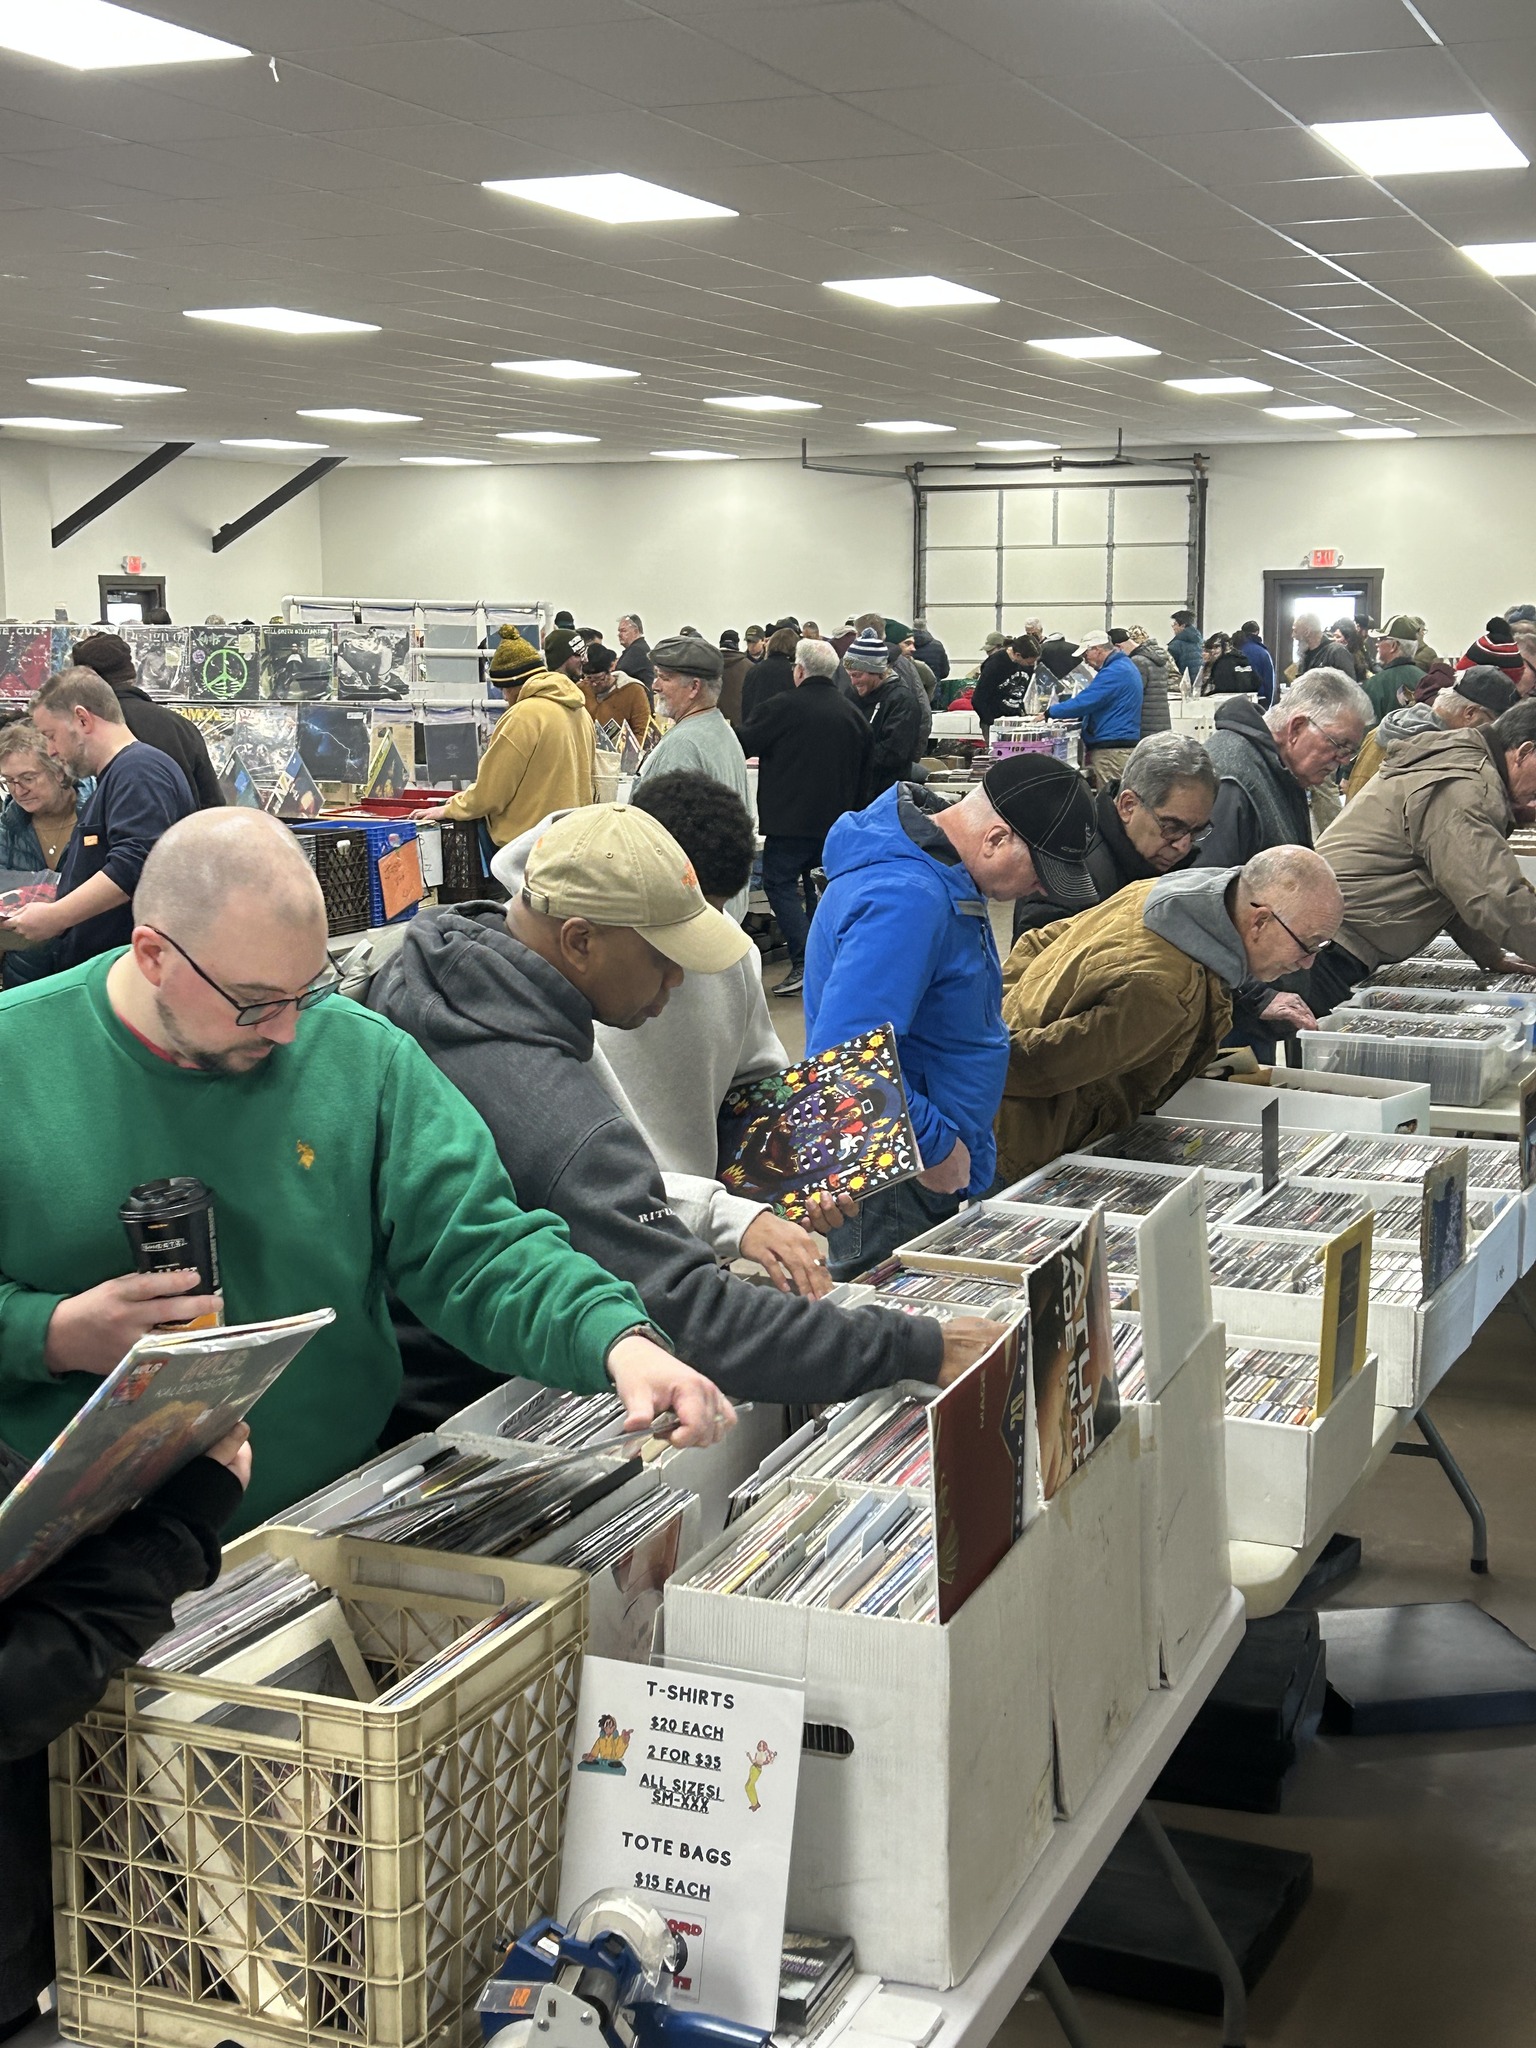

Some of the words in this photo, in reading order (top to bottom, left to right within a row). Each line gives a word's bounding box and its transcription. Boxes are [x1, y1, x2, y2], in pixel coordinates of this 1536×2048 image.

[638, 1207, 676, 1223] RITU
[646, 1680, 735, 1710] T-SHIRTS
[650, 1716, 678, 1733] $20
[682, 1721, 724, 1740] EACH
[647, 1745, 656, 1759] 2
[660, 1747, 690, 1765] FOR
[695, 1753, 721, 1770] $35
[640, 1773, 667, 1791] ALL
[622, 1831, 674, 1856] TOTE
[680, 1843, 732, 1867] BAGS
[634, 1872, 661, 1890] $15
[665, 1878, 711, 1901] EACH
